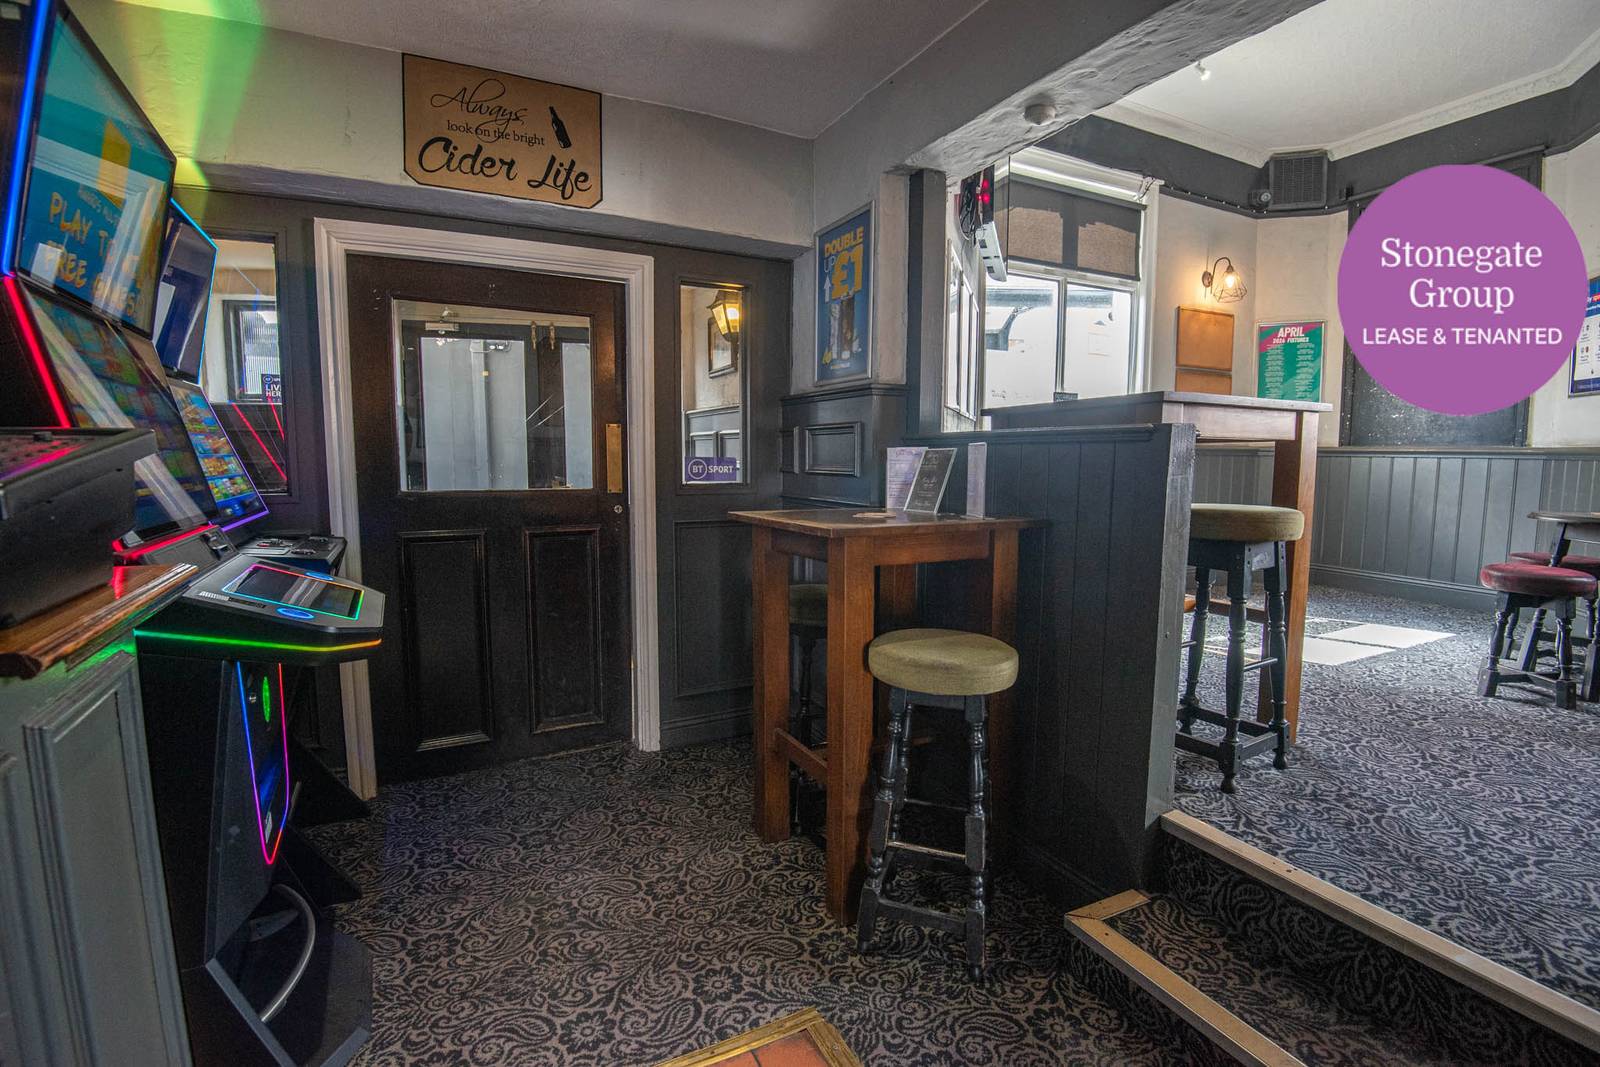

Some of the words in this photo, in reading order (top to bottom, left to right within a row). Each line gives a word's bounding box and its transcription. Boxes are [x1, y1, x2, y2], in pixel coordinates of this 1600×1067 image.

[430, 78, 527, 143] Always
[447, 120, 473, 133] look
[477, 127, 491, 138] on
[494, 128, 511, 141] the
[513, 130, 545, 147] bright
[418, 136, 518, 181] Cider
[527, 155, 592, 200] Life
[48, 191, 92, 245] PLAY
[825, 226, 864, 256] DOUBLE
[824, 256, 836, 272] UP
[832, 244, 863, 299] £1
[1278, 326, 1304, 337] APRIL
[692, 465, 703, 473] BT
[708, 465, 734, 473] SPORT
